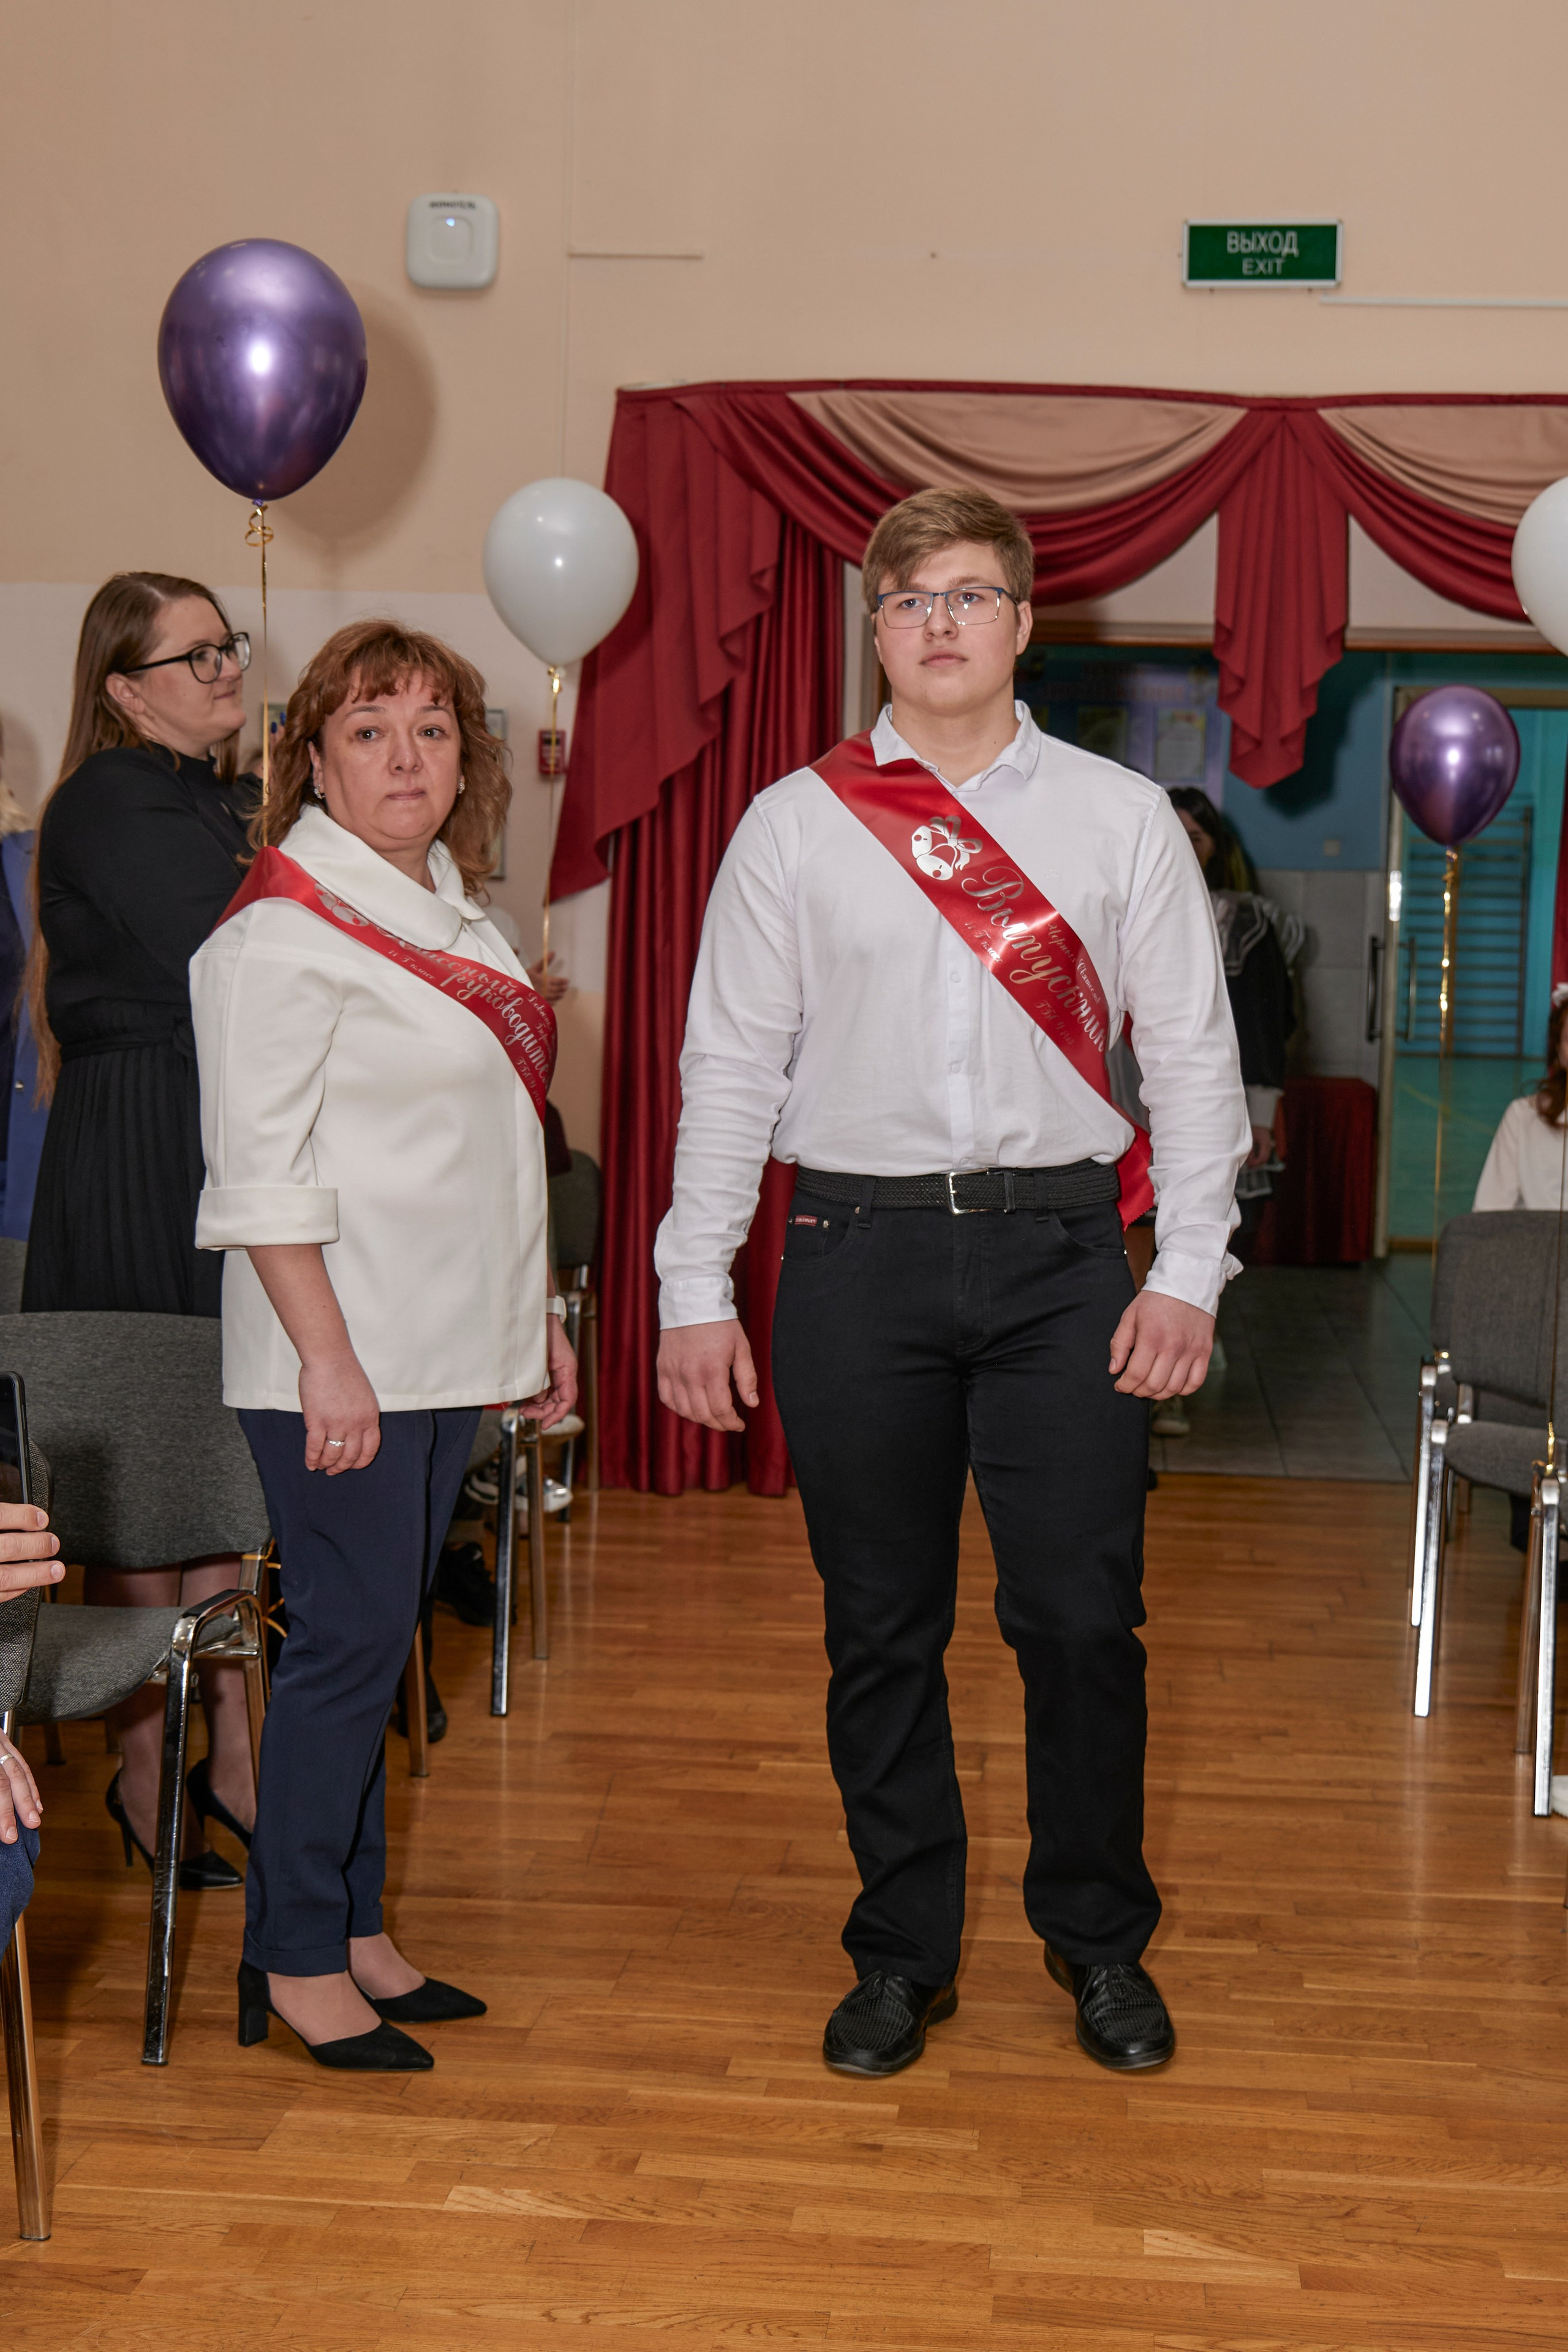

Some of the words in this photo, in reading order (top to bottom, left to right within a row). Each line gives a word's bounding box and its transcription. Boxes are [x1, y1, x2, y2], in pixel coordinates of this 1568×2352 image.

[1227, 230, 1299, 258] ВЫХОД
[1242, 257, 1286, 275] EXIT
[981, 941, 1003, 963] класс
[1048, 922, 1077, 963] Черных
[410, 964, 435, 979] класс
[961, 866, 1105, 1052] Выпускник
[516, 1057, 537, 1088] ГБОУ
